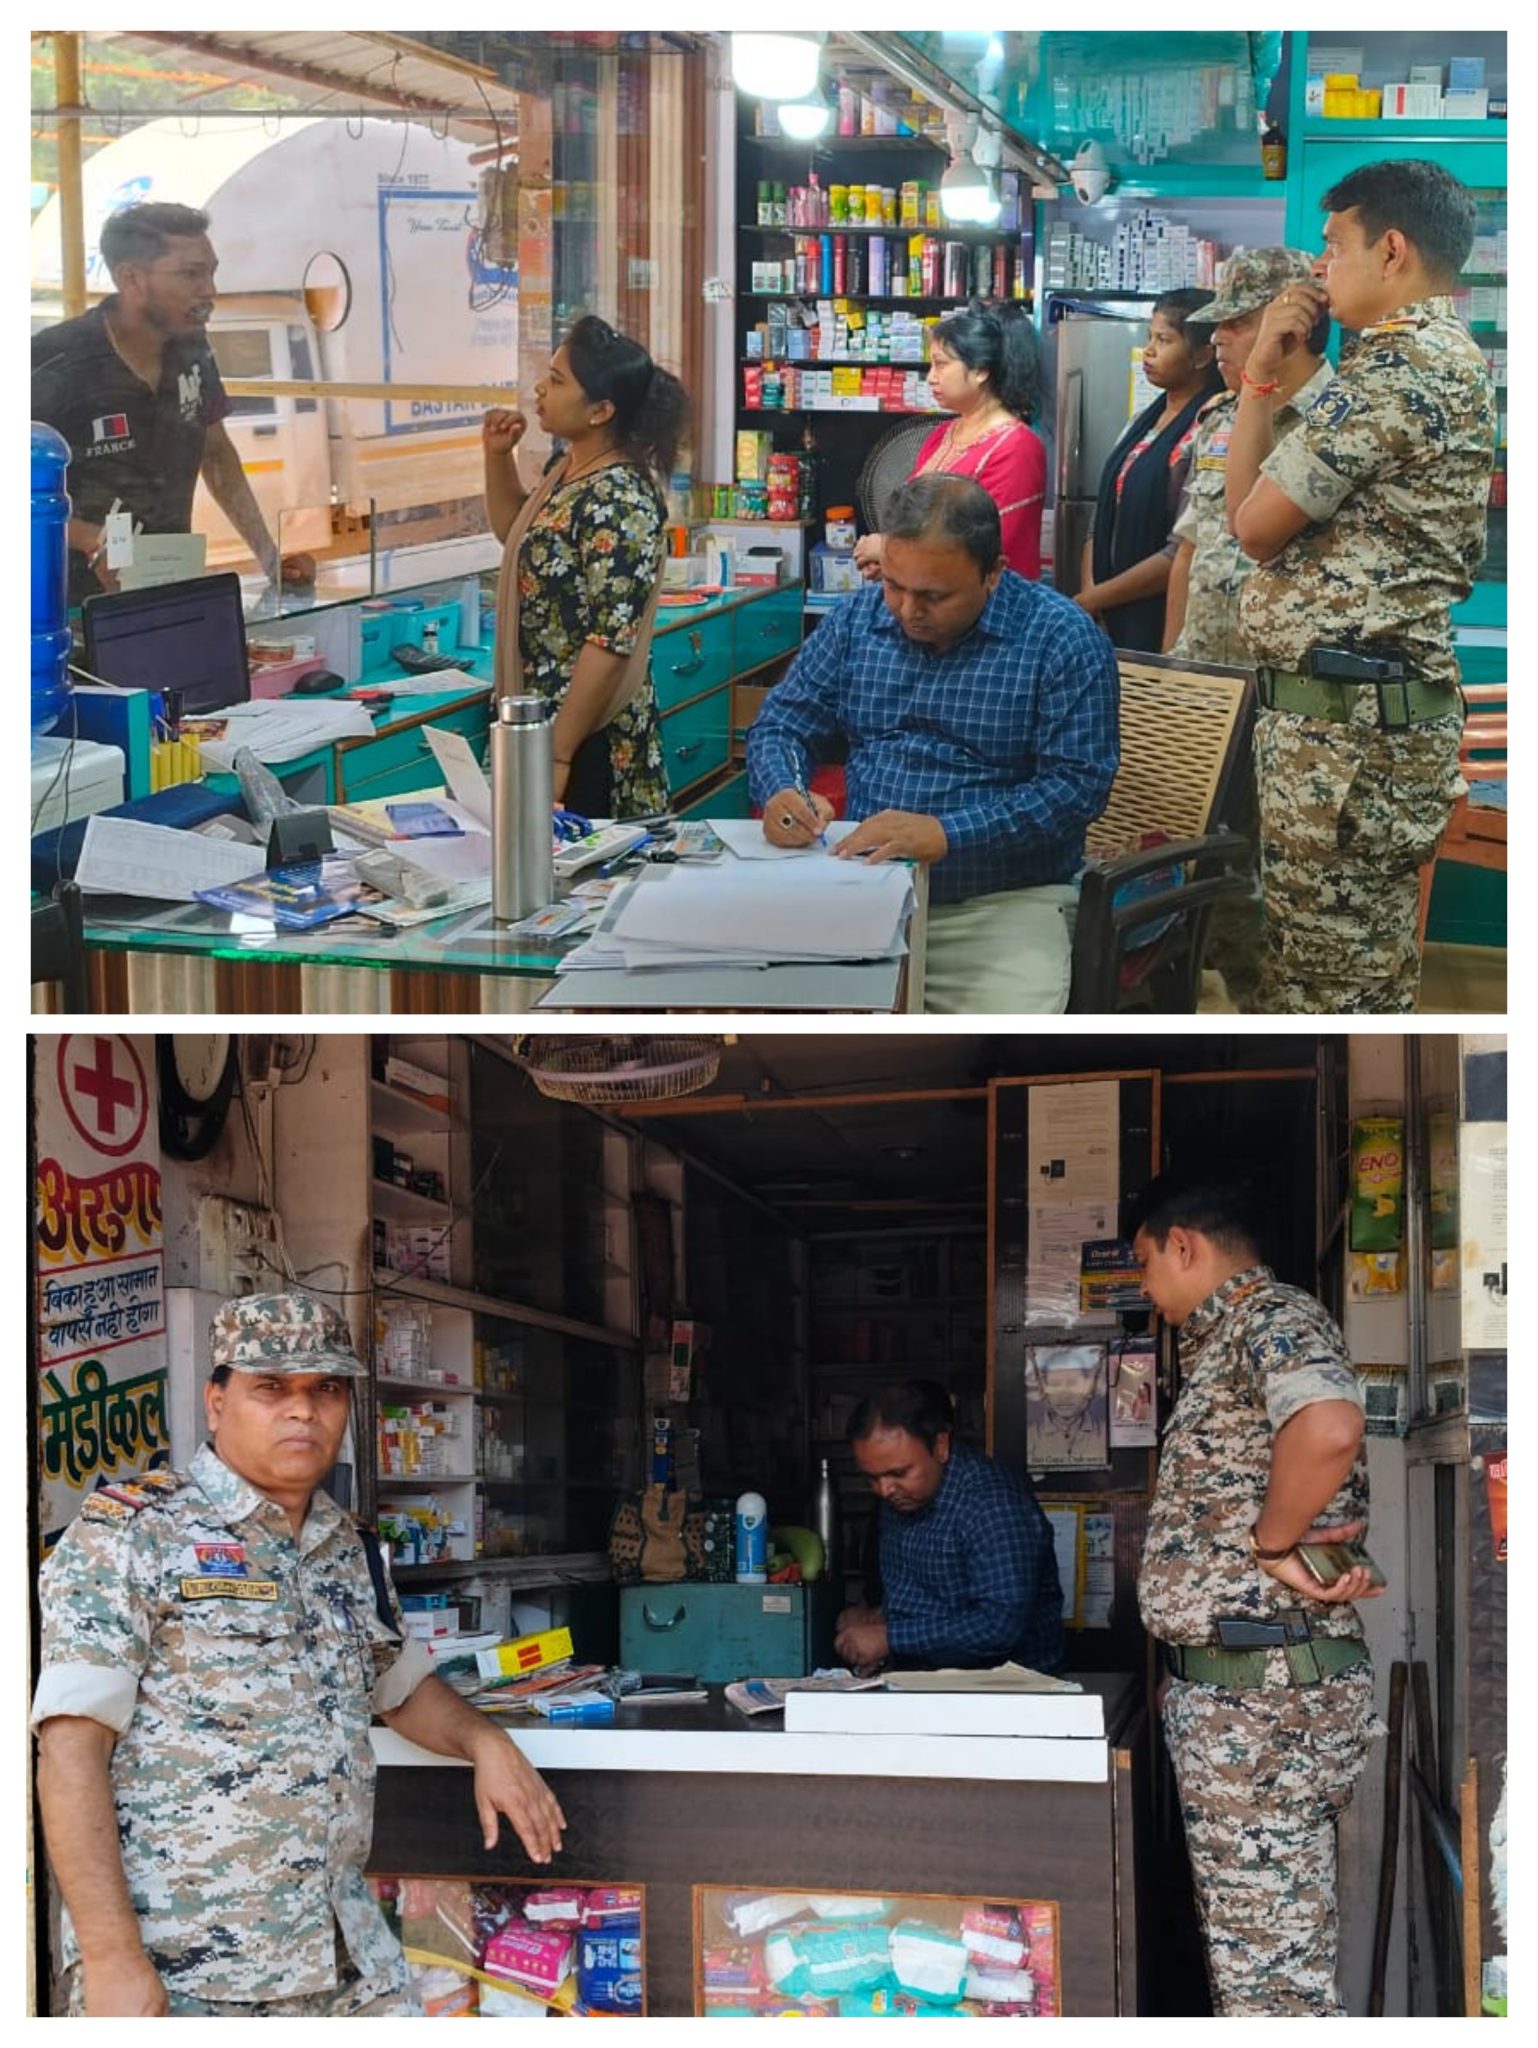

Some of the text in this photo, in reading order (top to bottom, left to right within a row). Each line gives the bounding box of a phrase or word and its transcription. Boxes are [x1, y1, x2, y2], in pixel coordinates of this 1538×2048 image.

[86, 439, 136, 458] FRANCE
[1359, 1152, 1398, 1172] ENO
[41, 1360, 169, 1486] मेडीकल
